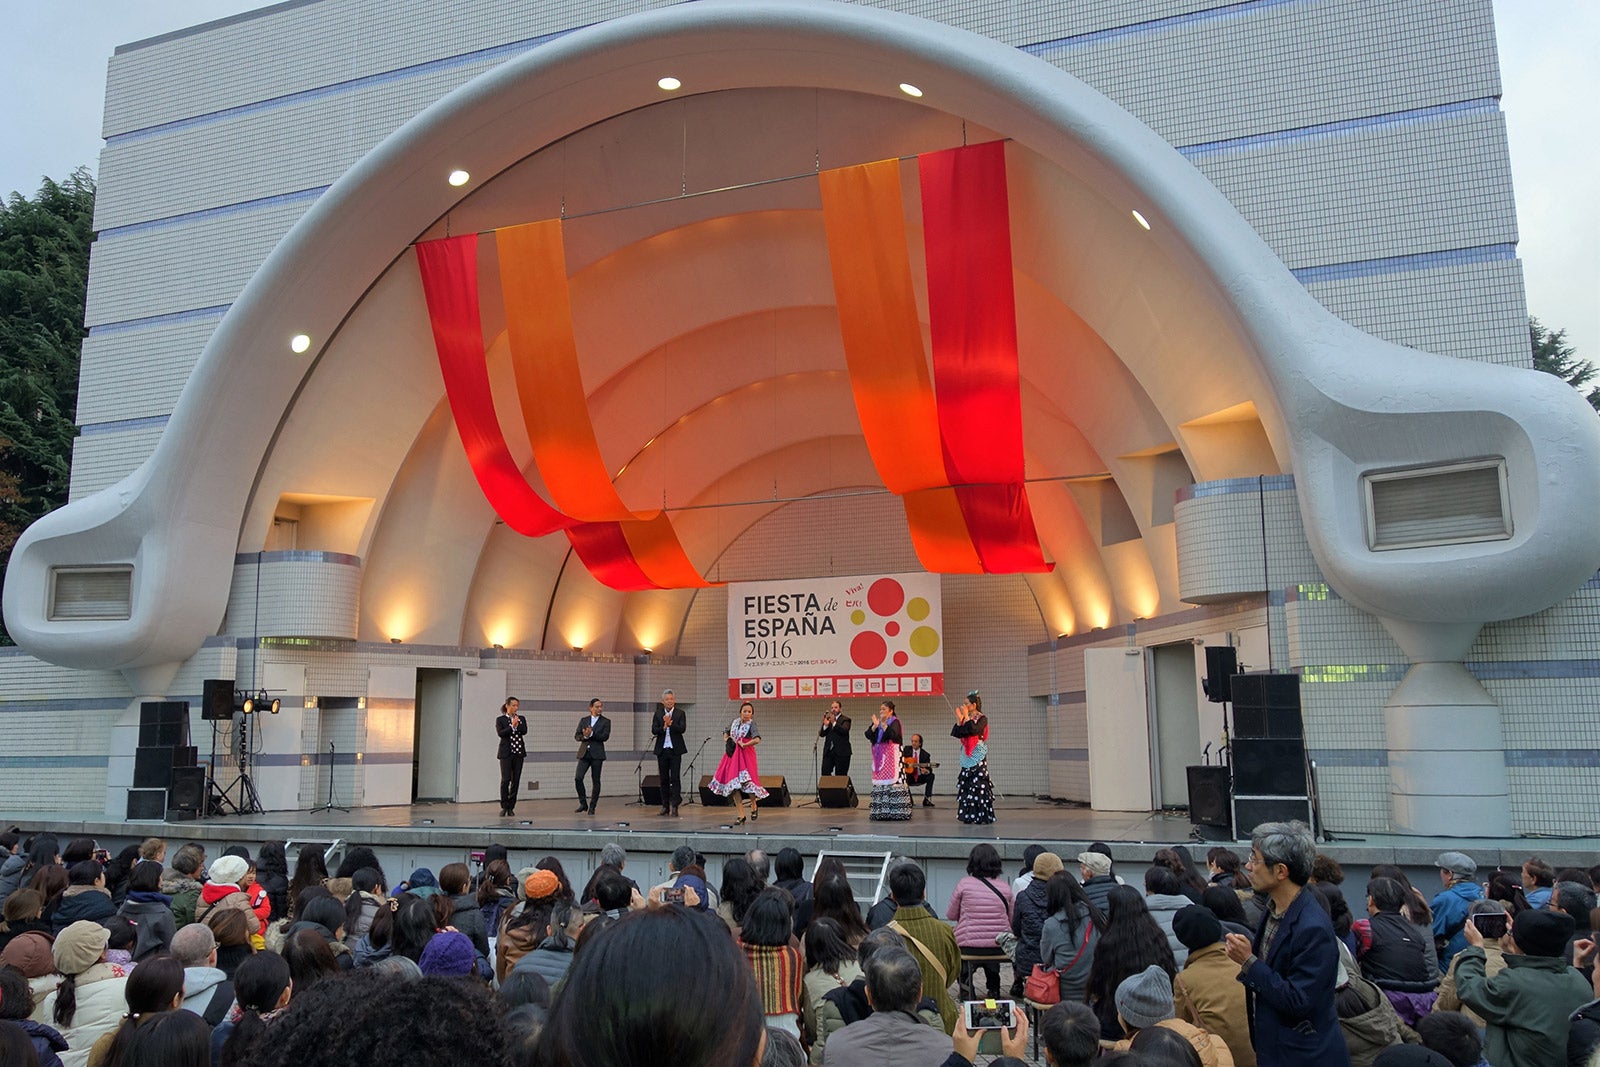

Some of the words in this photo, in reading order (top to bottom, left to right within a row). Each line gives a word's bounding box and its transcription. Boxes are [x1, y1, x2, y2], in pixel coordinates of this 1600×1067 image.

[845, 583, 864, 596] Viva!
[744, 593, 821, 615] FIESTA
[823, 597, 839, 612] de
[744, 611, 836, 638] ESPAÑA
[745, 639, 792, 660] 2016
